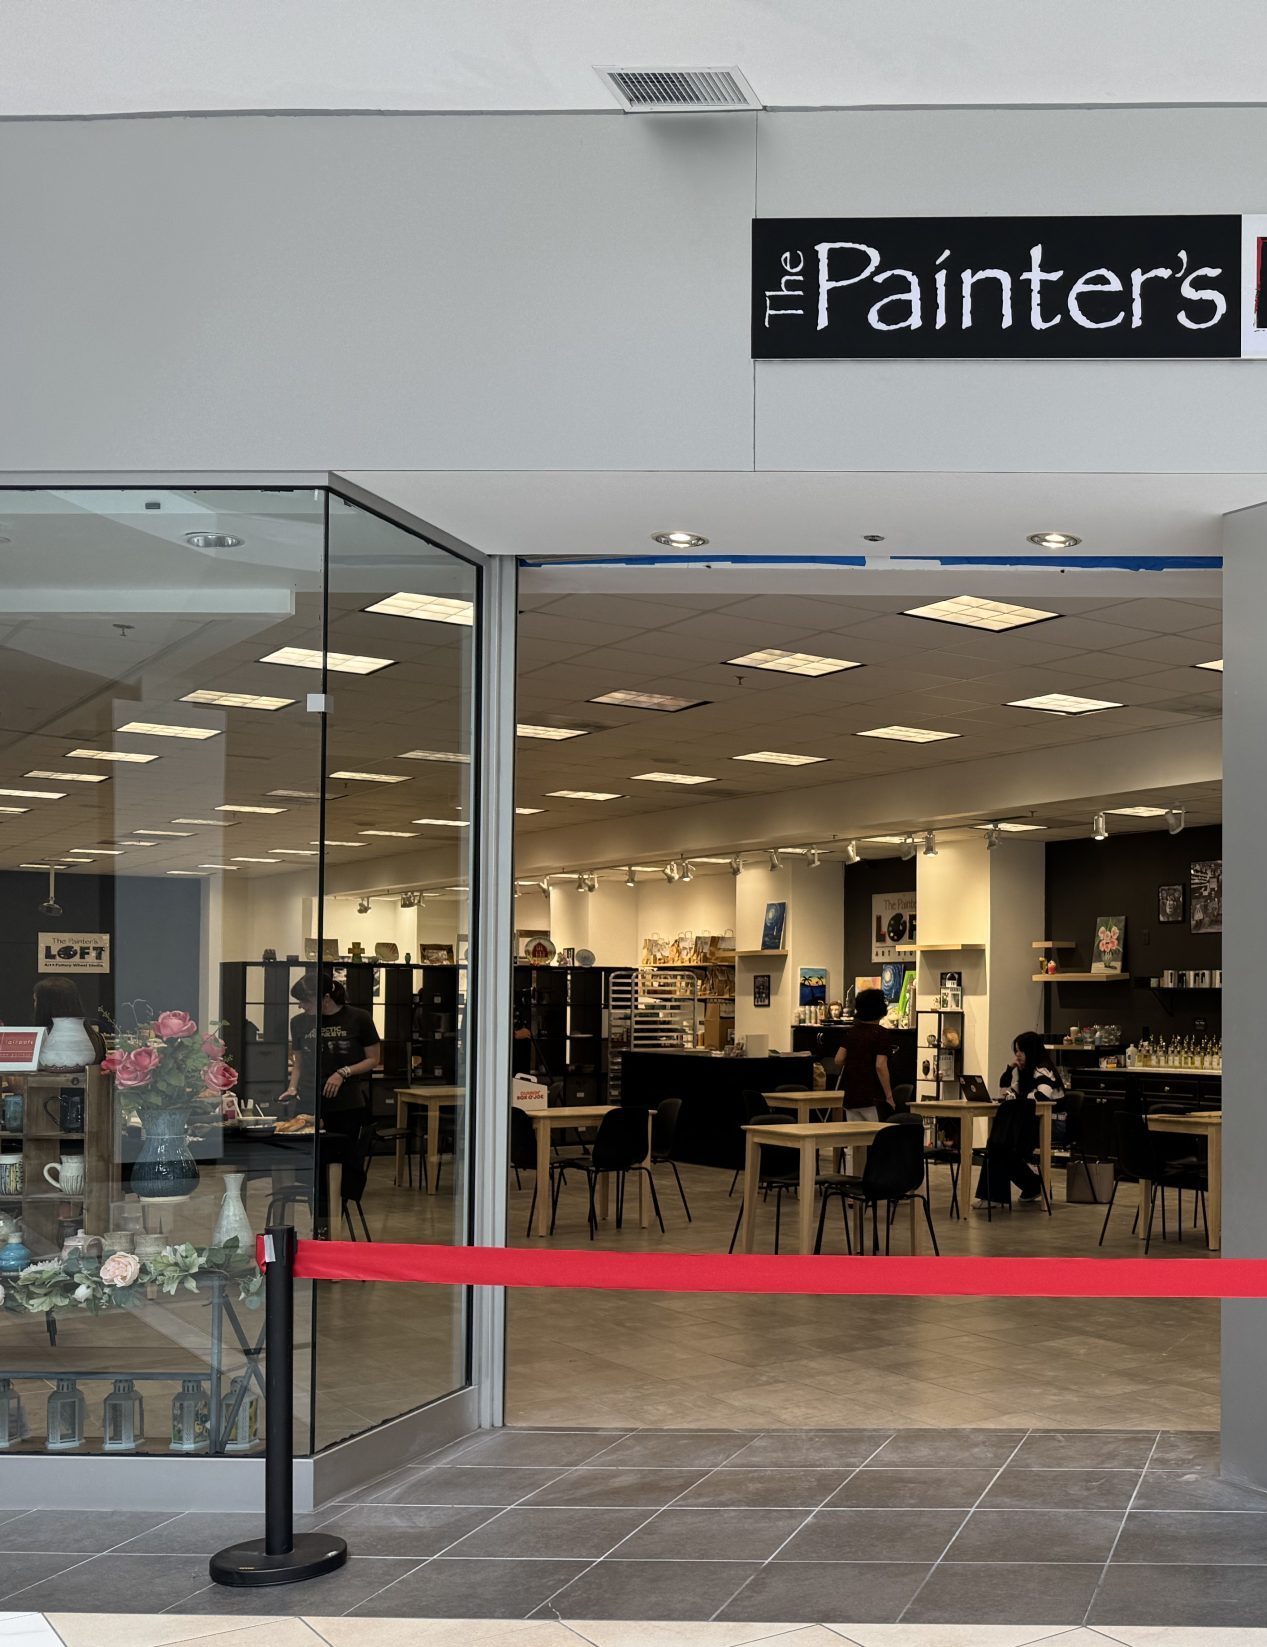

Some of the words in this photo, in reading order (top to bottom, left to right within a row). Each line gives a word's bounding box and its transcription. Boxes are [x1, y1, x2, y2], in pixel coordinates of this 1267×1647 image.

[764, 250, 804, 328] The
[814, 241, 1227, 331] Painter's
[44, 945, 105, 960] LOFT
